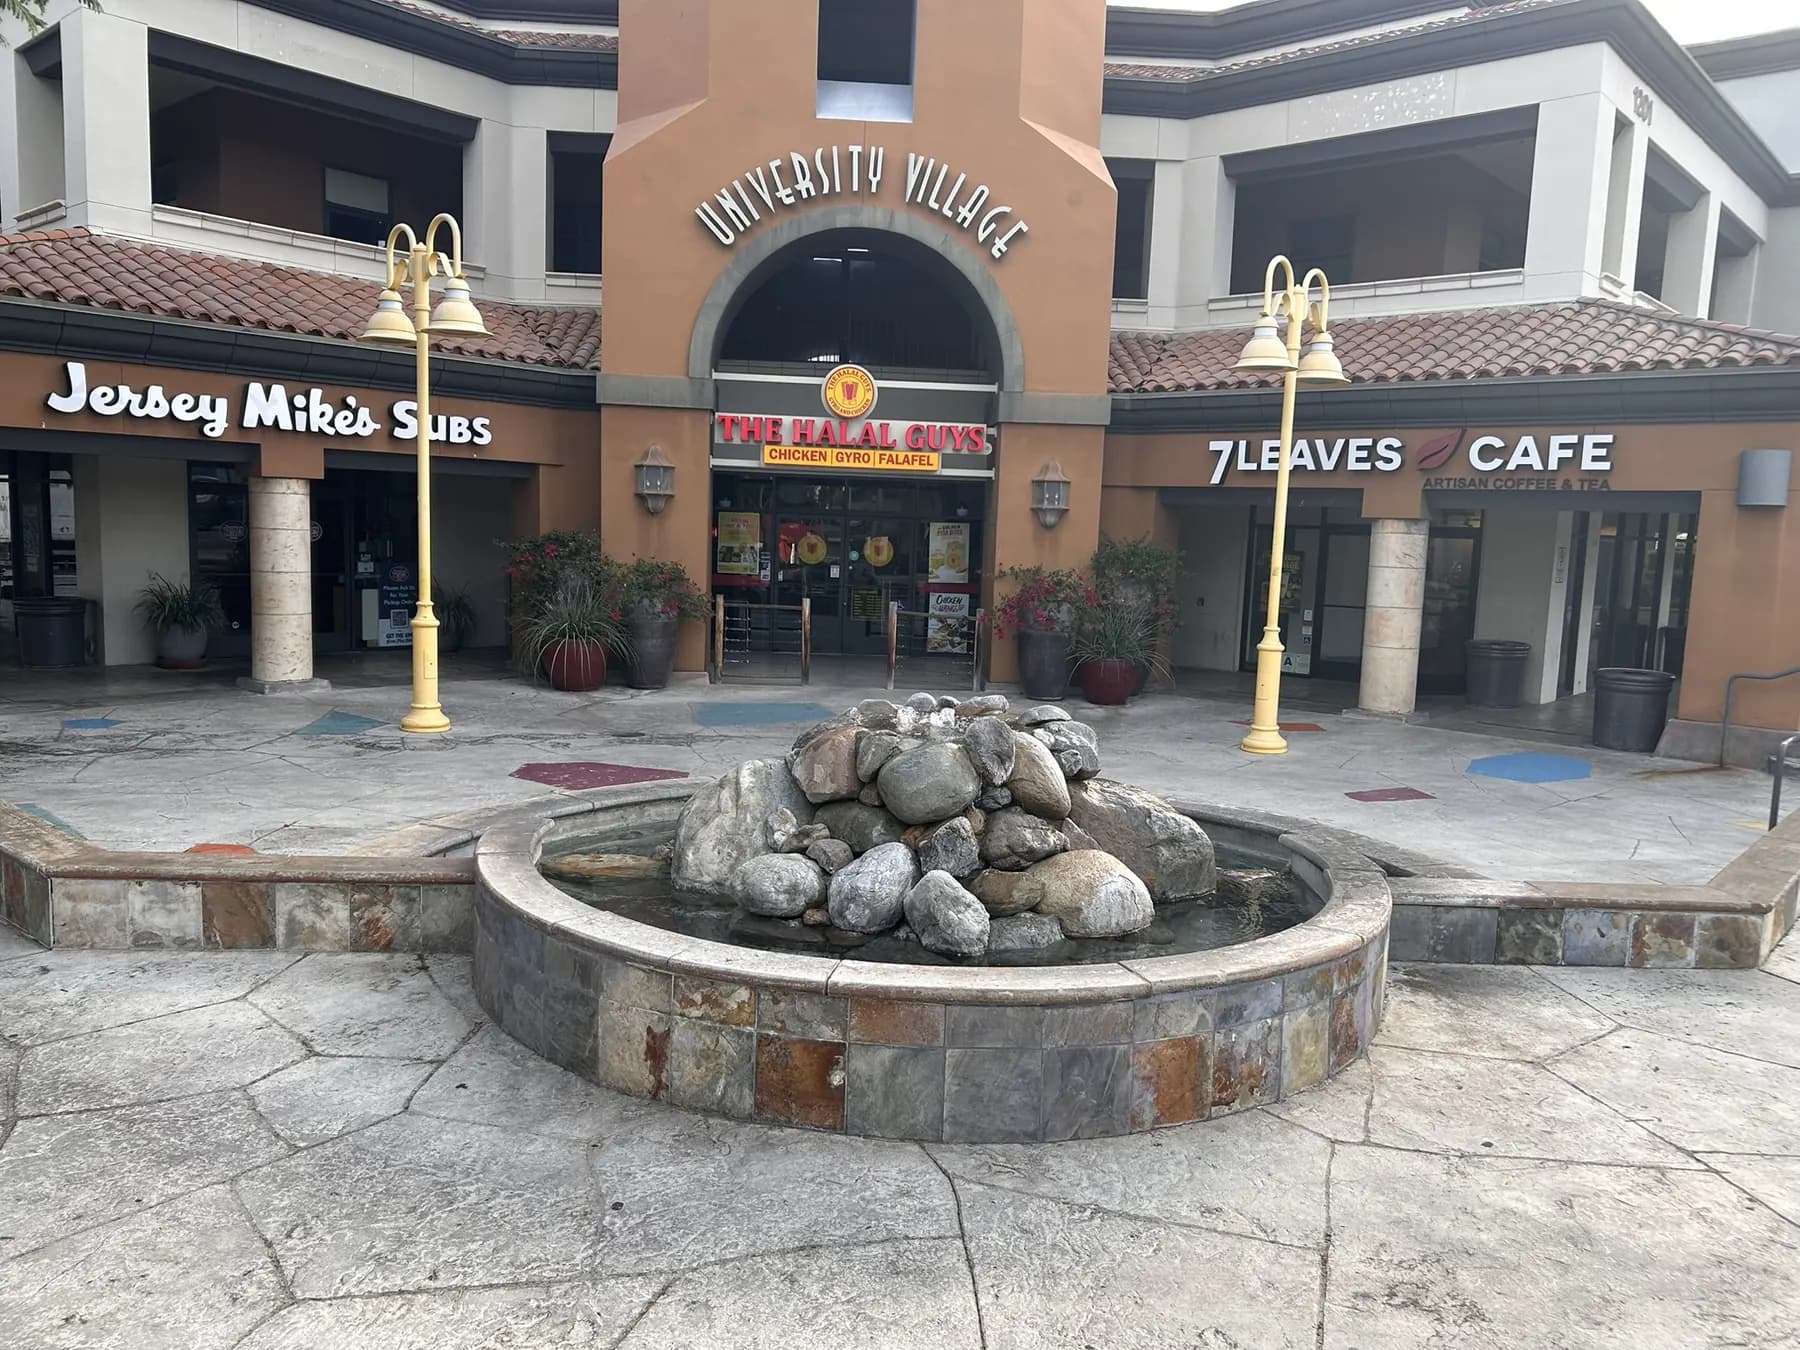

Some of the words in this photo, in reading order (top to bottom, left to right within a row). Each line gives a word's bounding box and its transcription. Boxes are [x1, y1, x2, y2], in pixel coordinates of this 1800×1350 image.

[694, 145, 885, 246] UNIVERSITY
[905, 152, 1029, 259] VILLAGE
[47, 361, 229, 438] Jersey
[242, 382, 382, 437] Mike's
[718, 415, 783, 443] THE
[791, 419, 897, 449] HALAL
[905, 425, 986, 451] GUYS
[768, 448, 828, 463] CHICKEN
[835, 451, 871, 465] GYRO
[878, 453, 934, 467] FALAFEL
[1469, 434, 1614, 471] CAFE
[1423, 477, 1490, 490] ARTISAN
[1492, 477, 1557, 490] COFFEE
[1561, 478, 1573, 490] &
[1578, 478, 1611, 491] TEA
[1283, 656, 1293, 666] A
